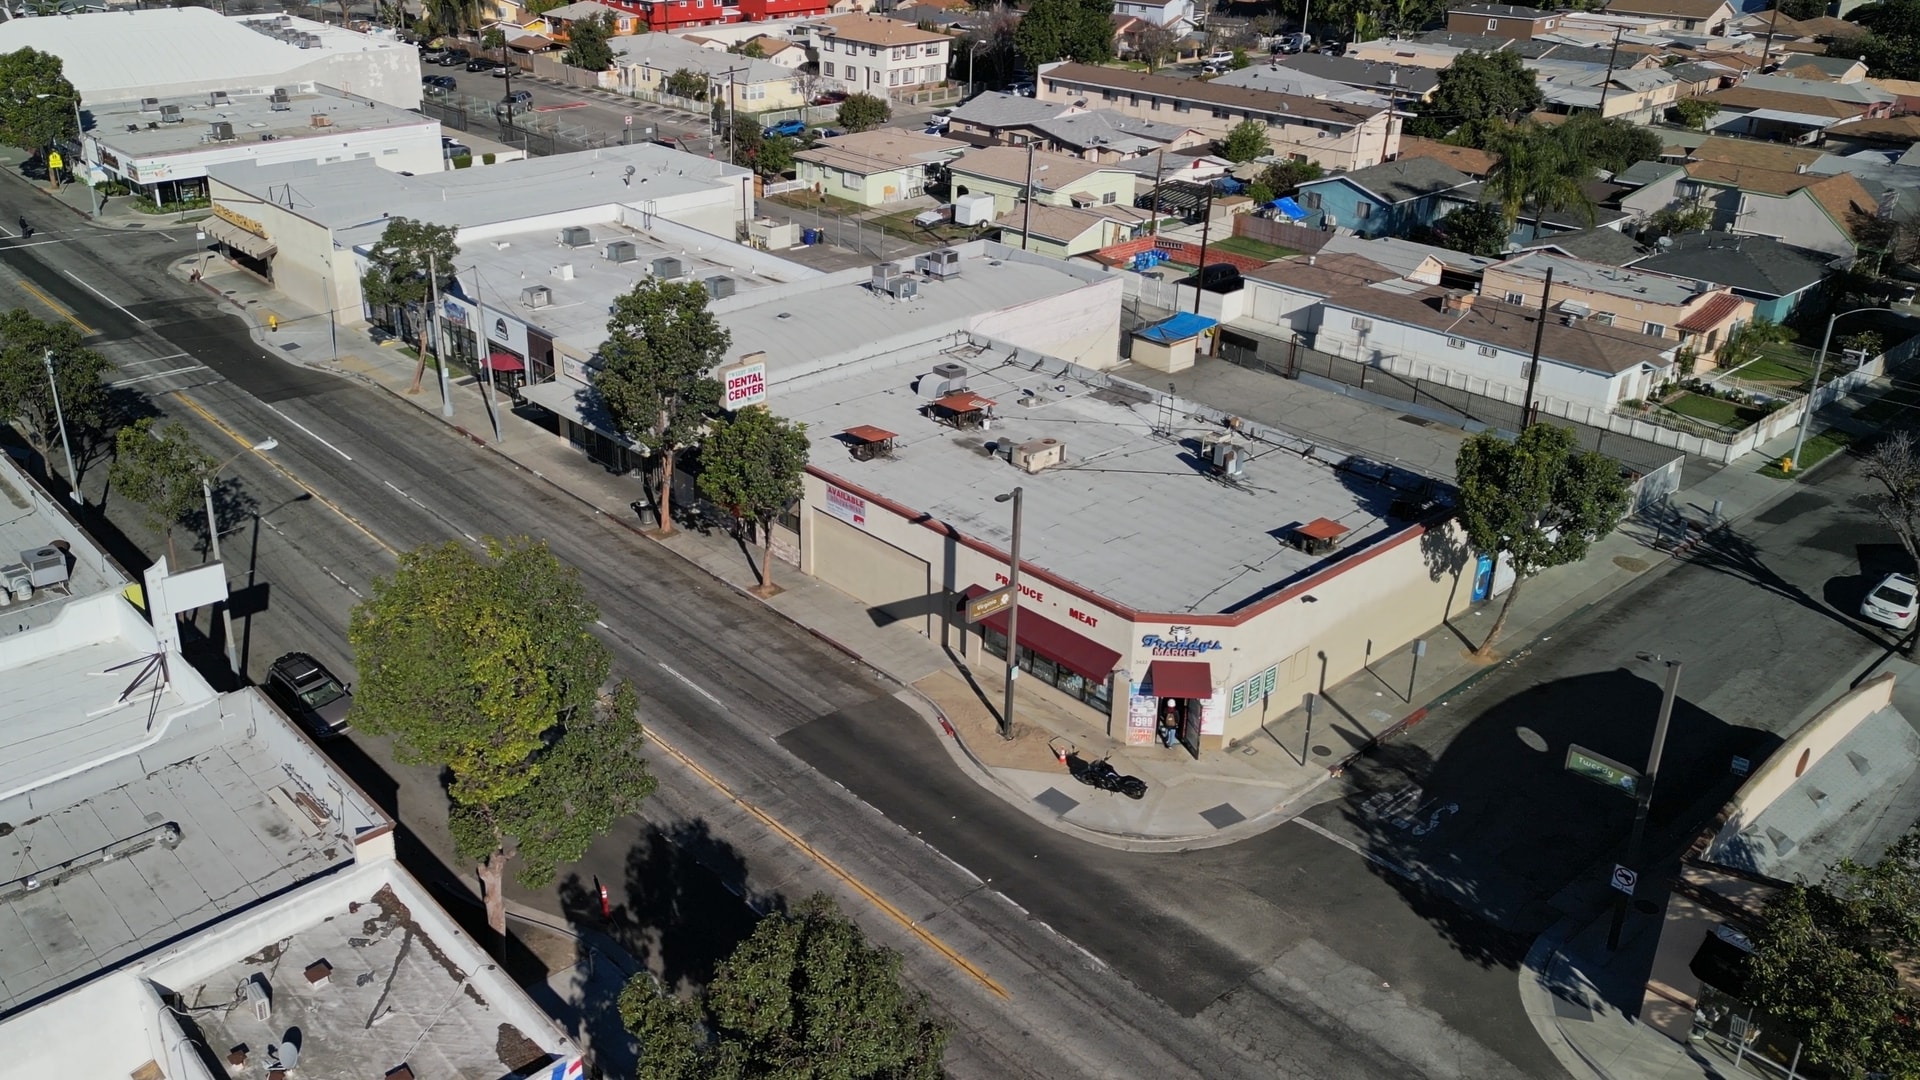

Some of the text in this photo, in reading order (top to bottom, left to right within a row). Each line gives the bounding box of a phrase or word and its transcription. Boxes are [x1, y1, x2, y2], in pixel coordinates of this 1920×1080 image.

[728, 372, 763, 390] DENTAL
[728, 383, 764, 401] CENTER
[828, 486, 863, 508] AVAILABLE
[977, 598, 997, 611] Virginia
[1069, 608, 1098, 628] MEAT
[1142, 634, 1222, 653] Freddy's
[1152, 647, 1198, 657] MARKET
[1578, 757, 1614, 778] Tweedy
